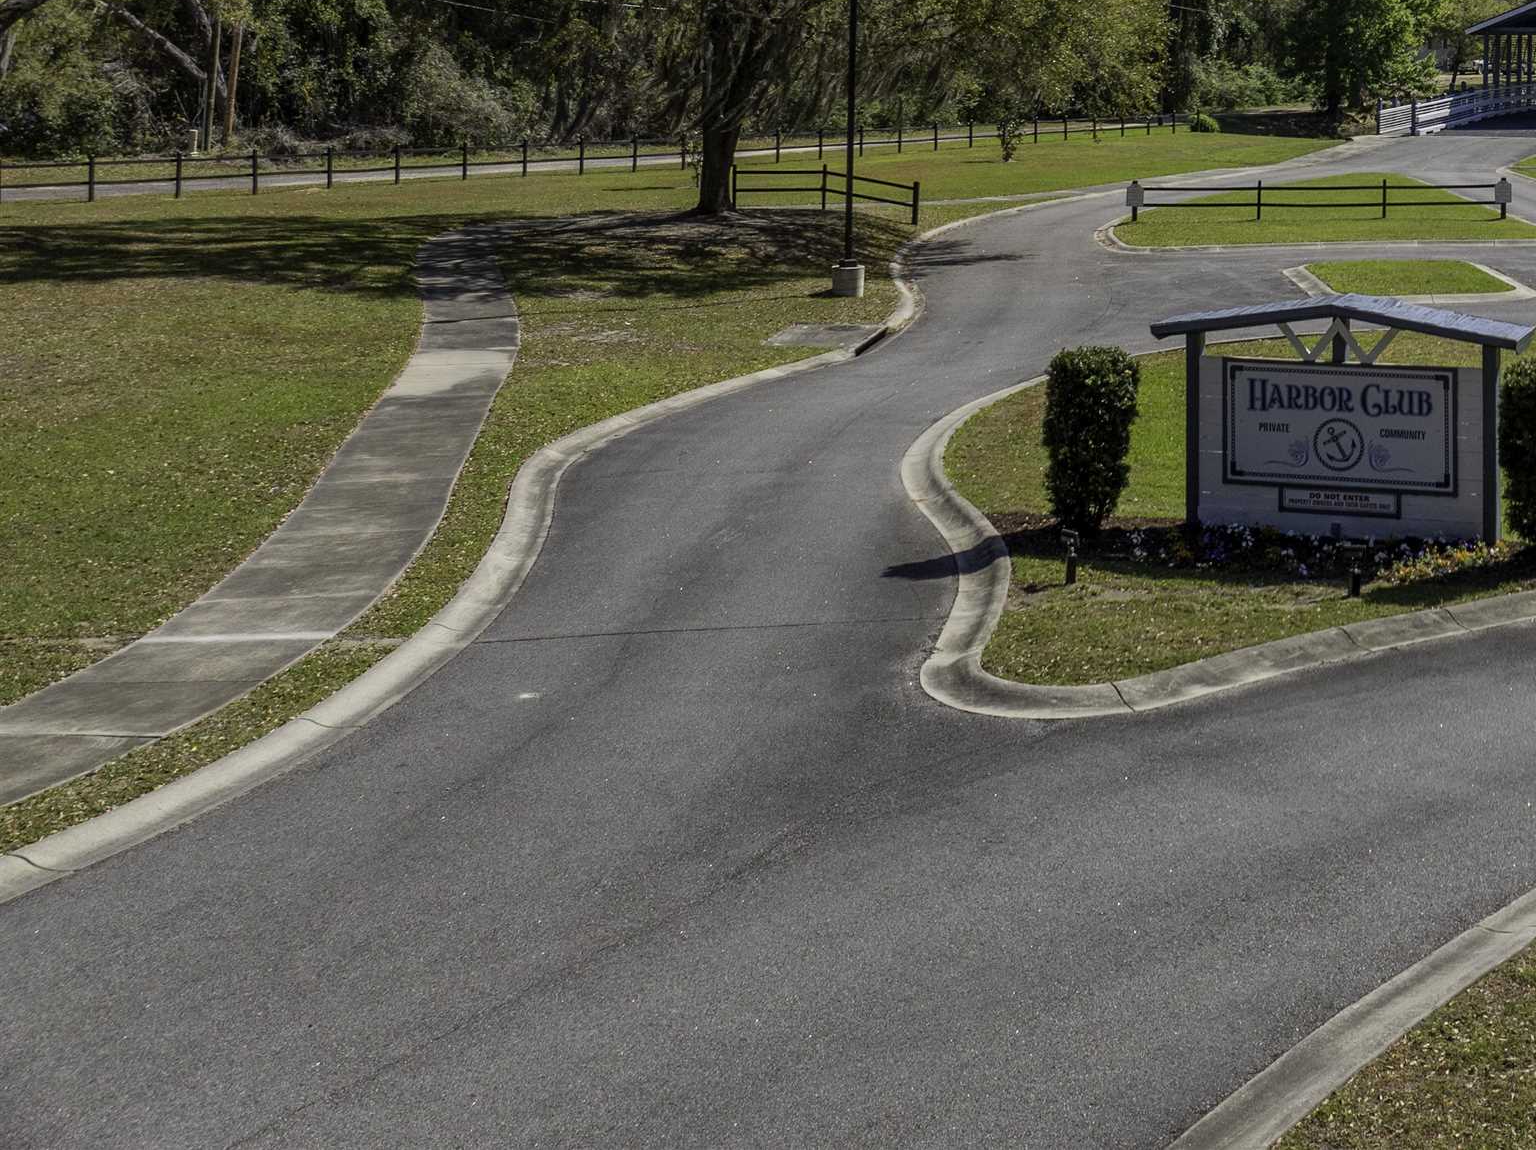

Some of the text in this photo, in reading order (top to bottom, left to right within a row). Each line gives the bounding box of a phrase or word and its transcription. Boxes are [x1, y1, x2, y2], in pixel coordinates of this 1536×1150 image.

[1247, 378, 1433, 417] HARBOR CLUB
[1258, 422, 1427, 441] PRIVATE COMMUNITY
[1309, 492, 1371, 502] DO NOT ENTER
